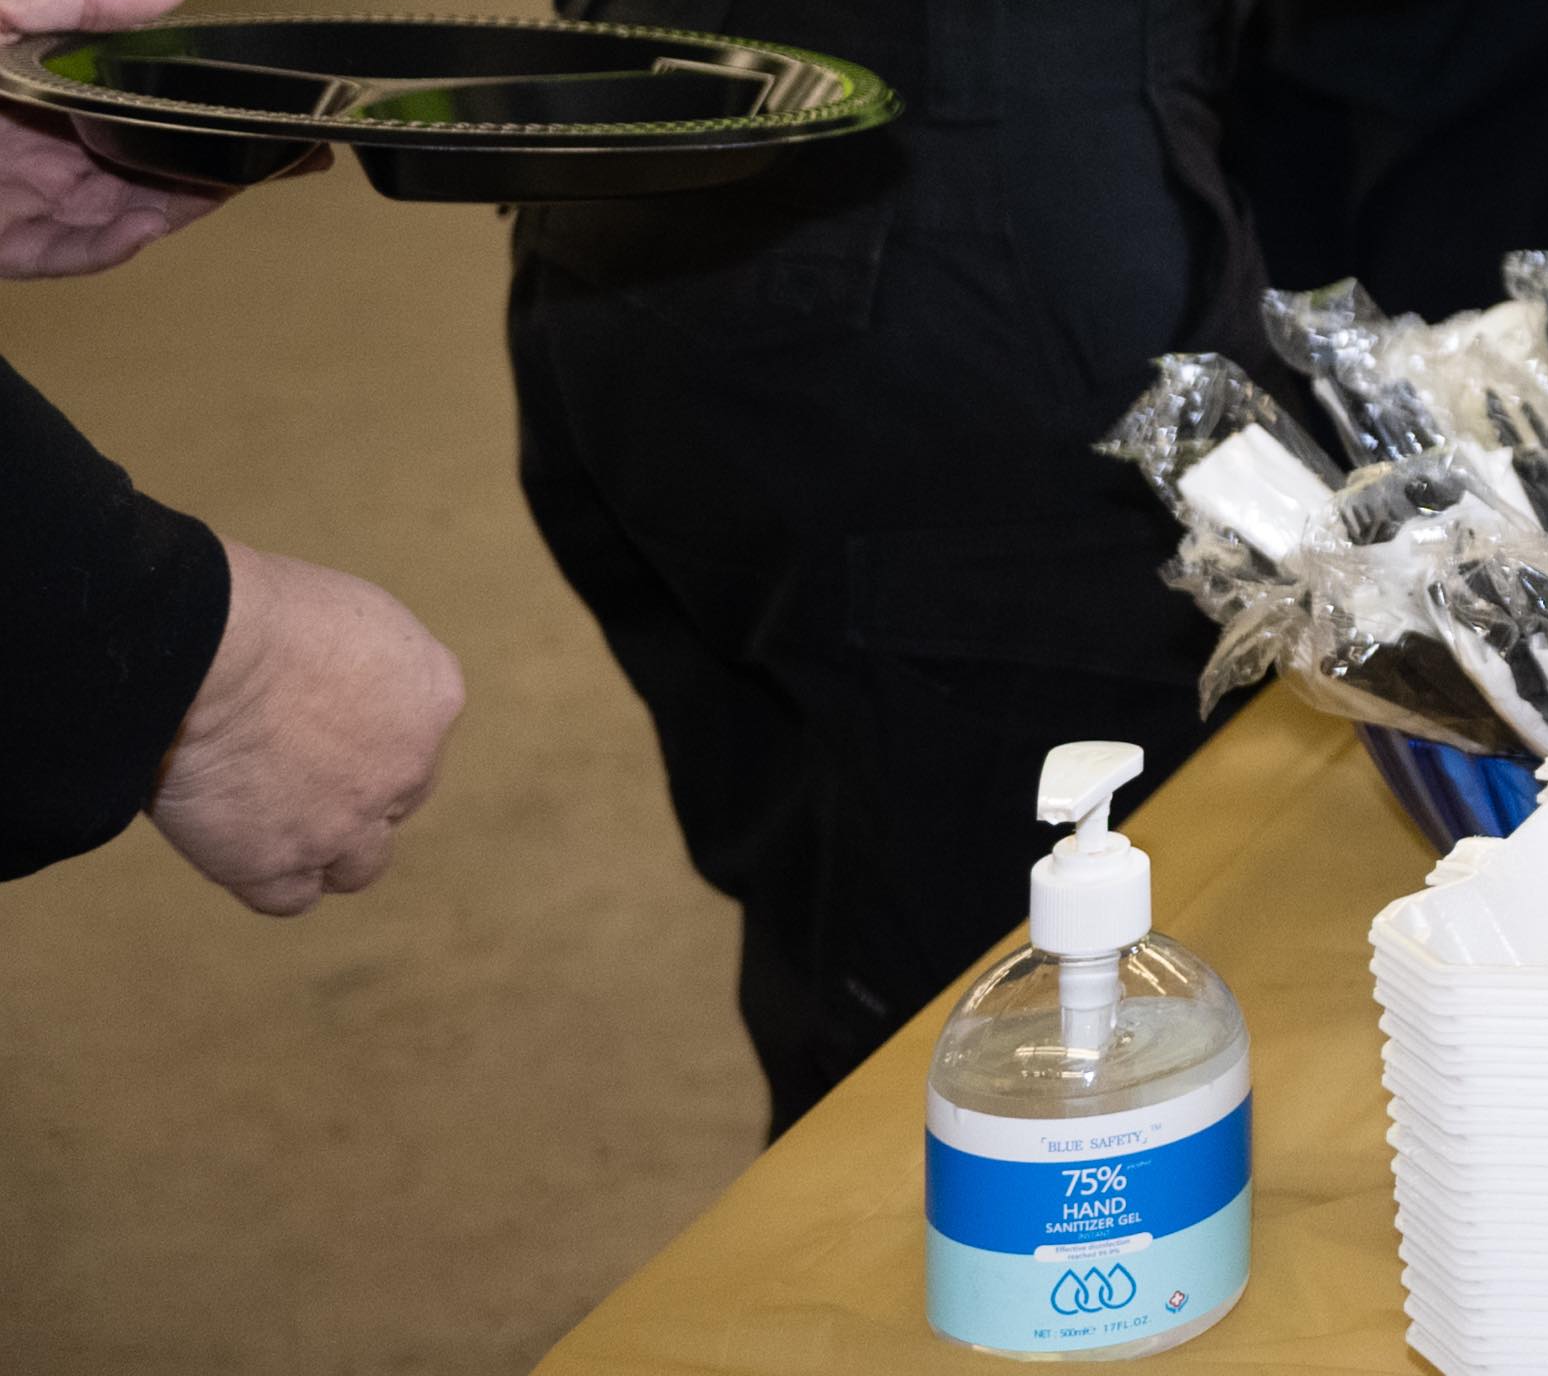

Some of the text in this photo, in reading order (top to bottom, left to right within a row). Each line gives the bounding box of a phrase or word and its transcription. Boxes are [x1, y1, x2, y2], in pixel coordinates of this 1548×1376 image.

[1062, 1163, 1127, 1197] 75%
[1063, 1197, 1127, 1220] HAND
[1045, 1212, 1142, 1234] SANITIZER GEL
